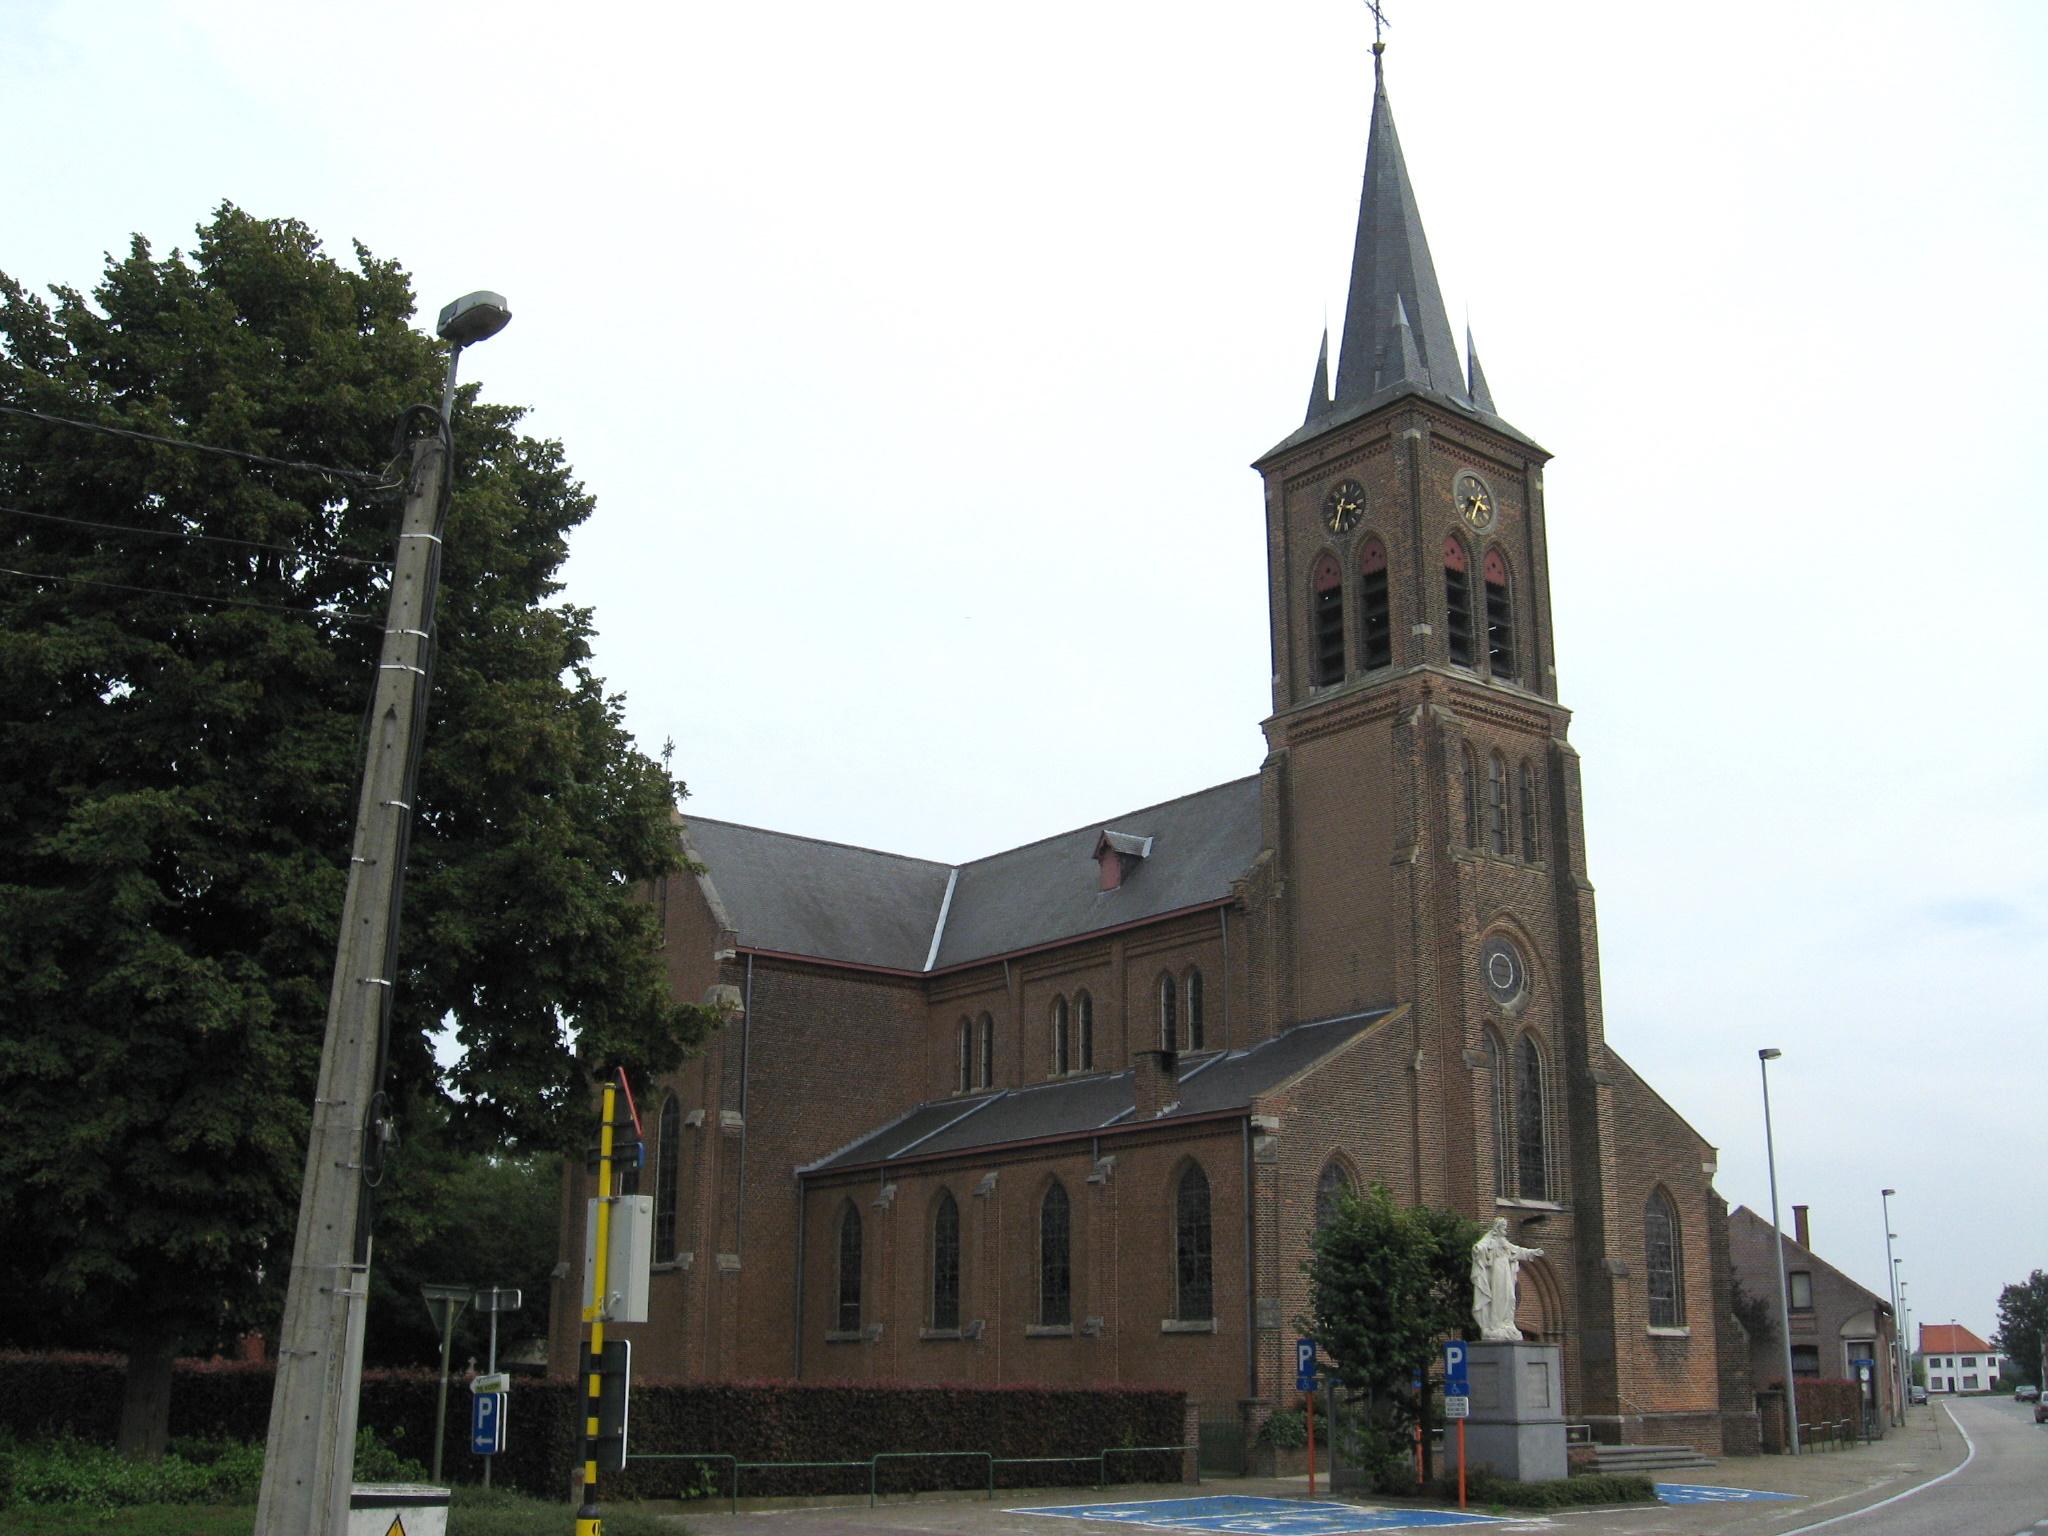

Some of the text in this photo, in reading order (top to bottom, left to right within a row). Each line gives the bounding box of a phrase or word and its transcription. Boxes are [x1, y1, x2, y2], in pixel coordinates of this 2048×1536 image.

[1298, 1345, 1313, 1372] P
[1446, 1346, 1463, 1375] P
[478, 1396, 493, 1429] P
